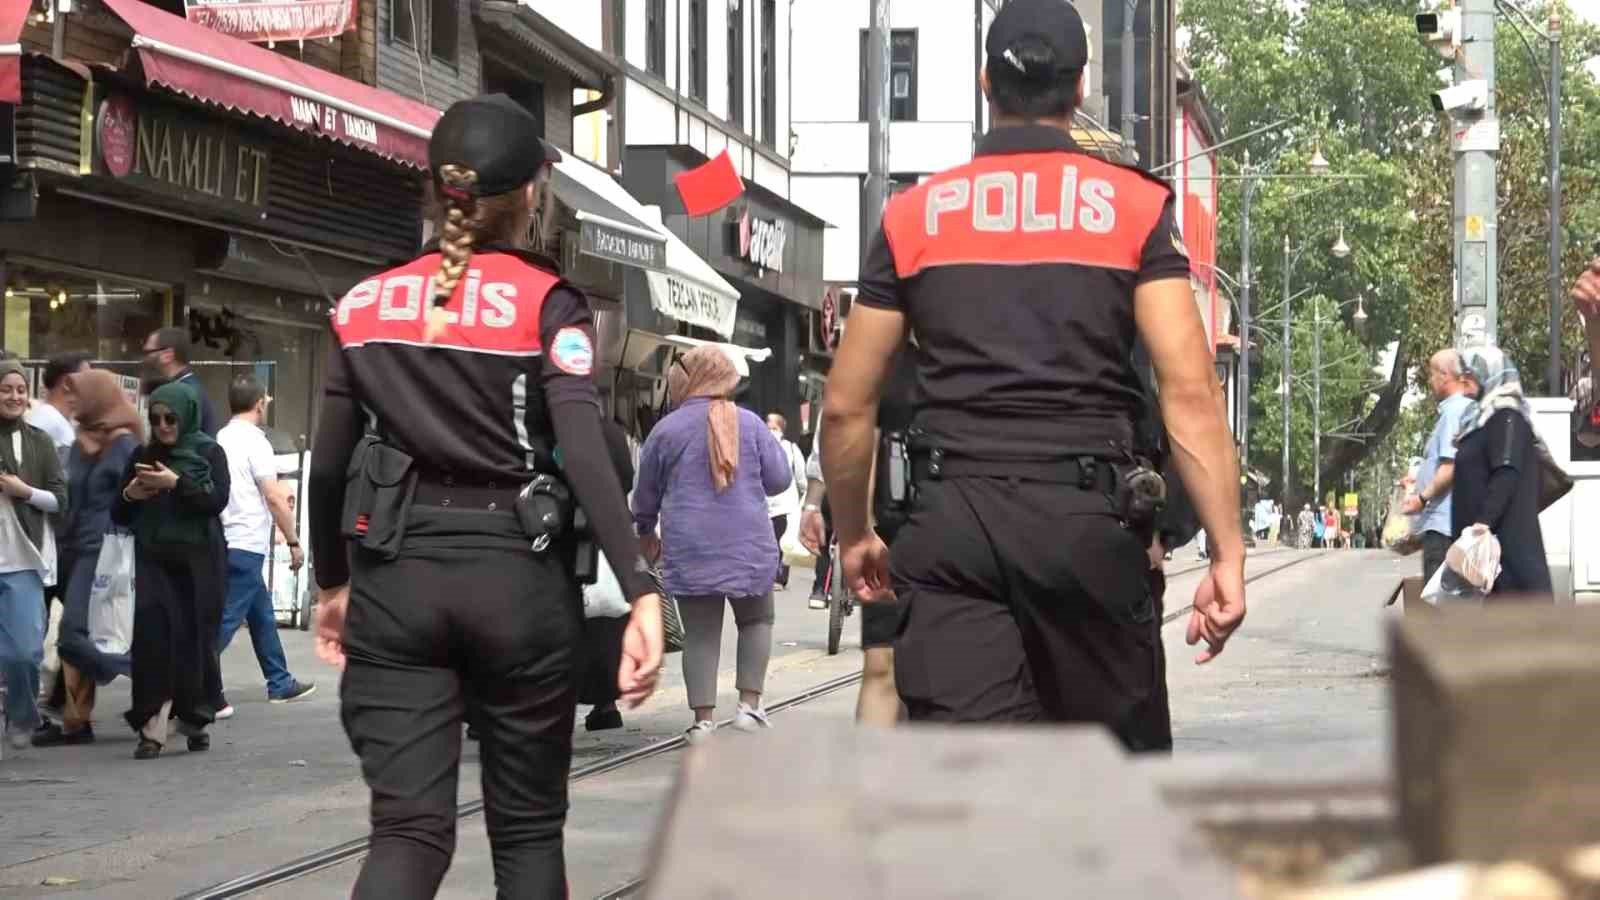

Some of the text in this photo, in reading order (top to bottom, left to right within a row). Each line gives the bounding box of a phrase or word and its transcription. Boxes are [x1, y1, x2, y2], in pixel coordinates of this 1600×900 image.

[325, 106, 337, 132] ET
[133, 113, 226, 198] NAMLI
[234, 144, 267, 206] ET
[926, 164, 1116, 235] POLİS
